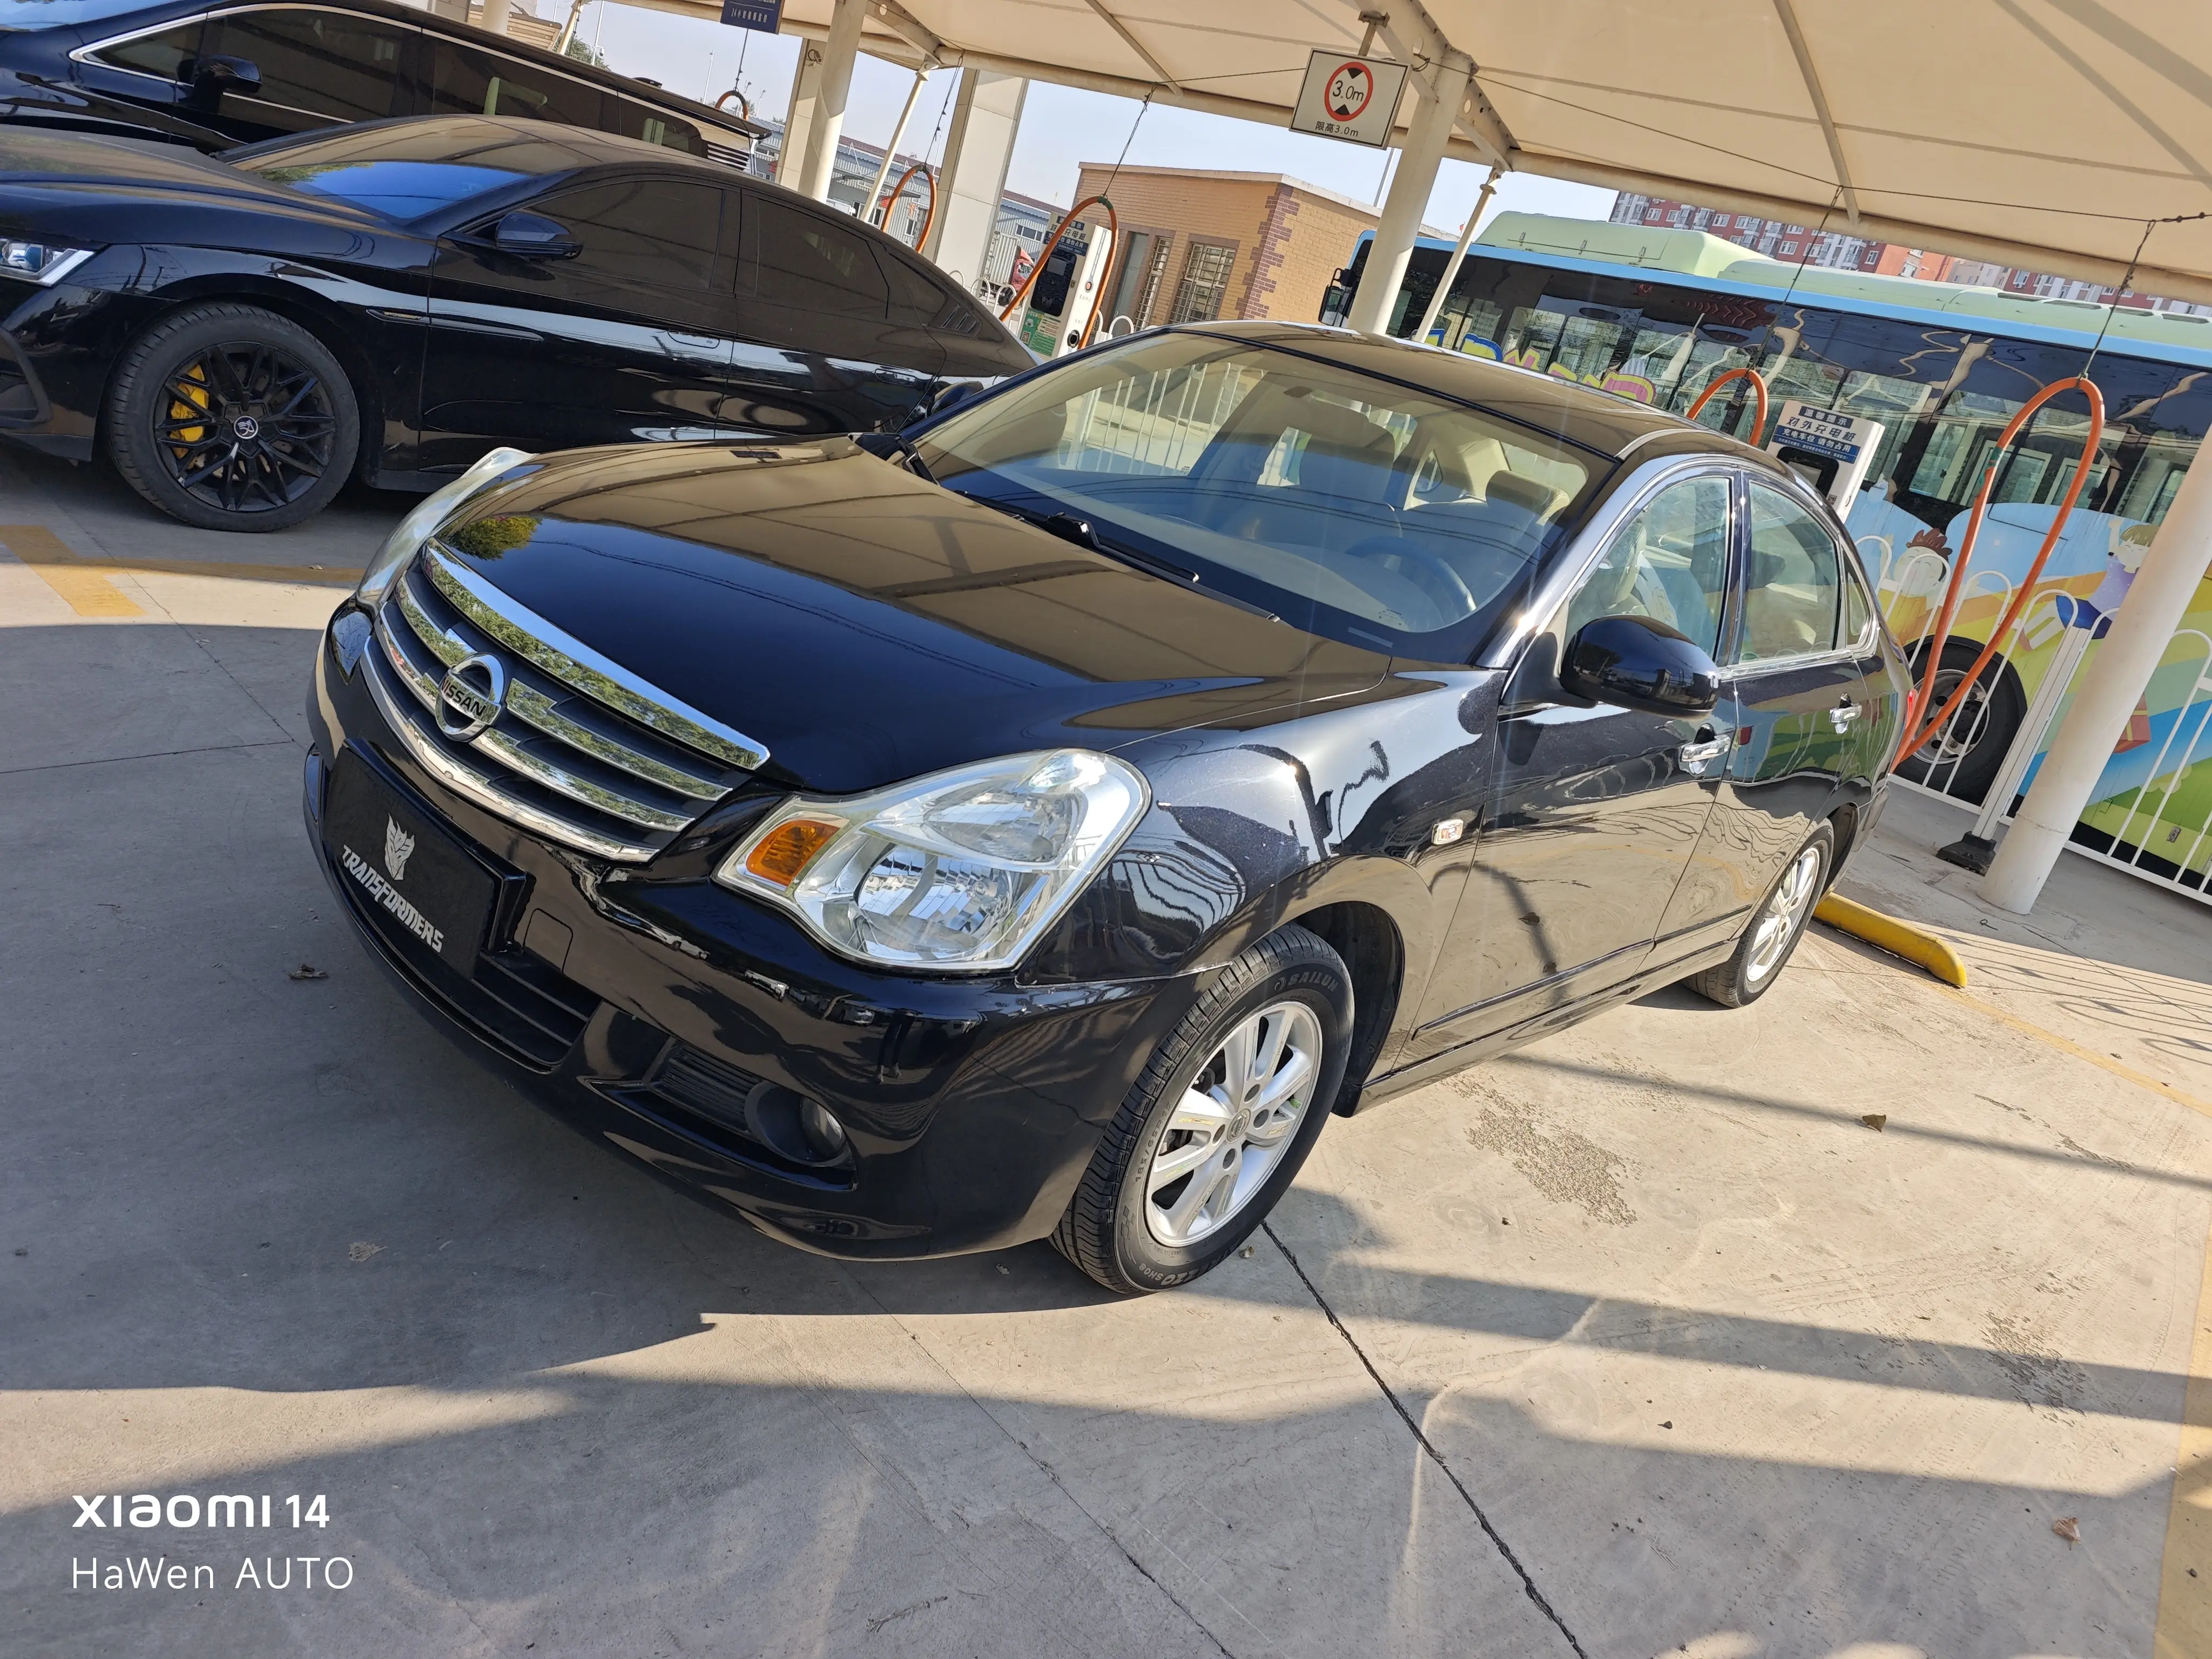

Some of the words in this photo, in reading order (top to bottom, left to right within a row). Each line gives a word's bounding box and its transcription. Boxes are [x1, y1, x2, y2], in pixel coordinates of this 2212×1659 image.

[1332, 80, 1364, 102] 3.0m
[1315, 120, 1359, 137] 限高3.0m
[1786, 416, 1857, 442] 对外充电桩
[1803, 408, 1848, 426] 温馨提示
[1782, 427, 1816, 443] 充电车位
[1817, 438, 1851, 453] 请勿占用
[441, 676, 486, 717] NISSAN
[341, 844, 444, 953] TRANSFORMERS
